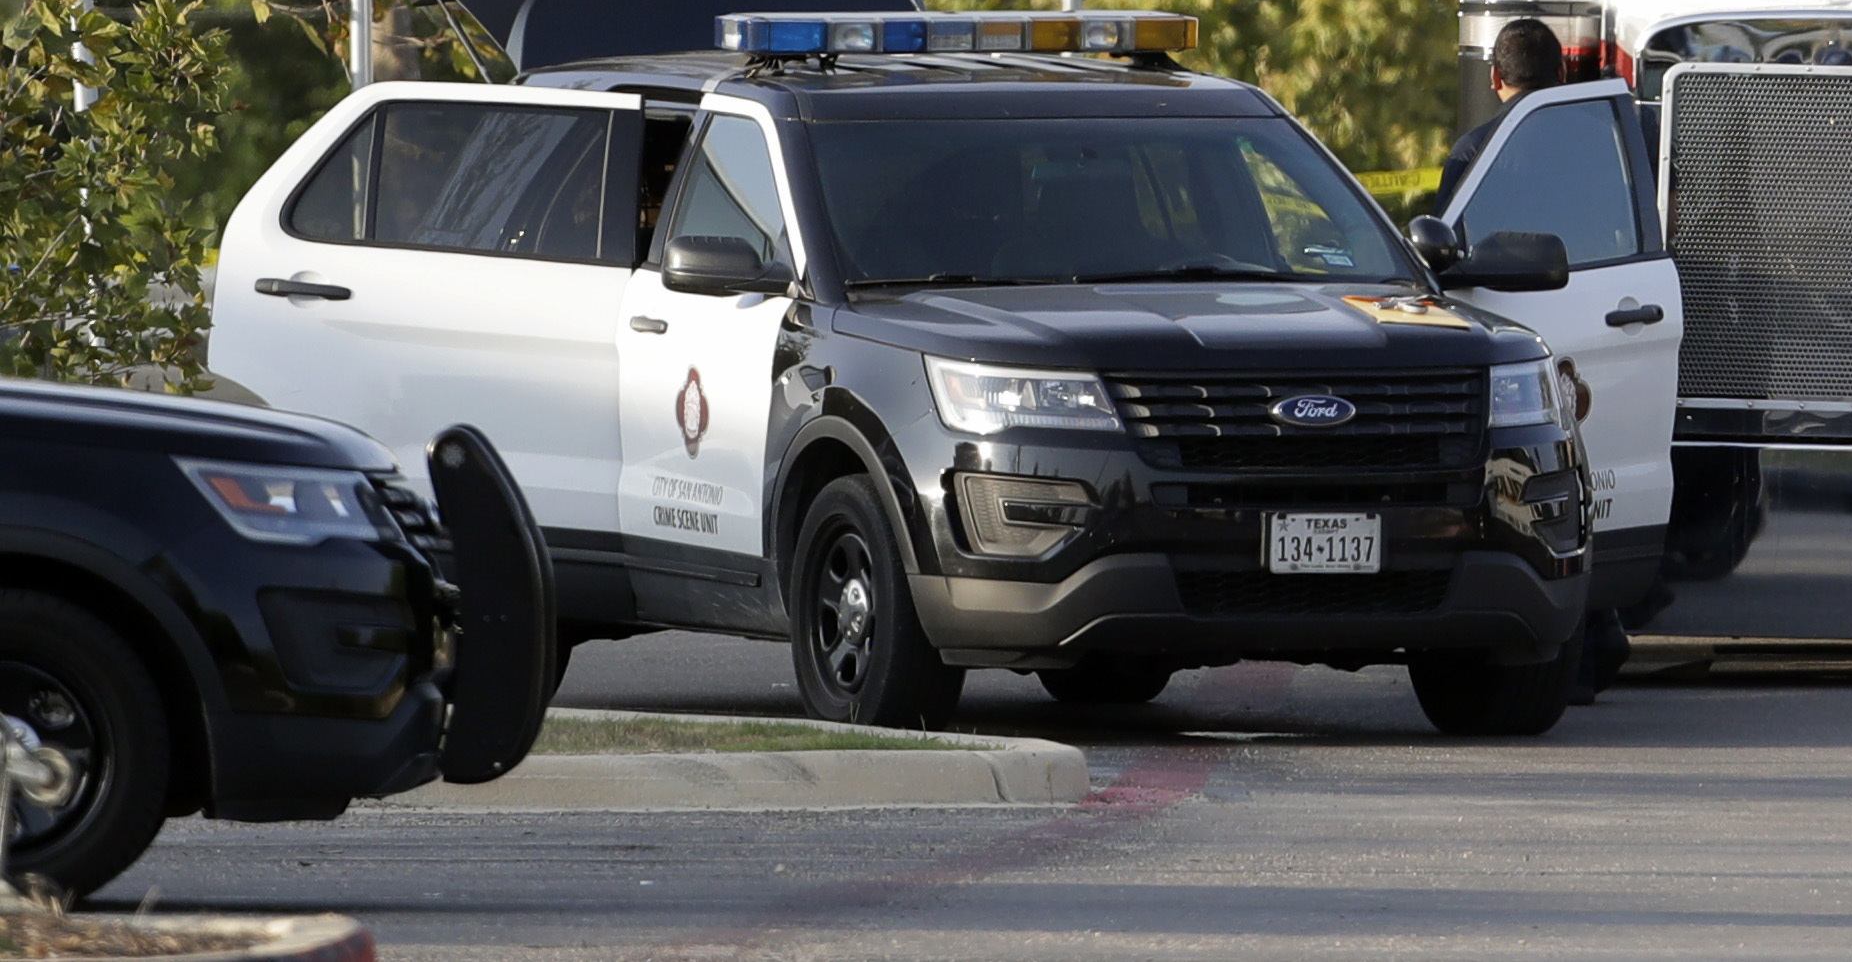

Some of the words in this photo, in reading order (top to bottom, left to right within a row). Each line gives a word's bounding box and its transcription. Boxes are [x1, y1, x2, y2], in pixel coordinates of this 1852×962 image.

[1294, 399, 1338, 417] Ford
[652, 476, 669, 496] CITY
[668, 479, 678, 498] OF
[677, 480, 692, 500] SAN
[691, 483, 723, 505] ANTONIO
[653, 505, 676, 528] CRIME
[677, 508, 700, 532] SCENE
[701, 512, 718, 534] UNIT
[1305, 518, 1347, 529] TEXAS
